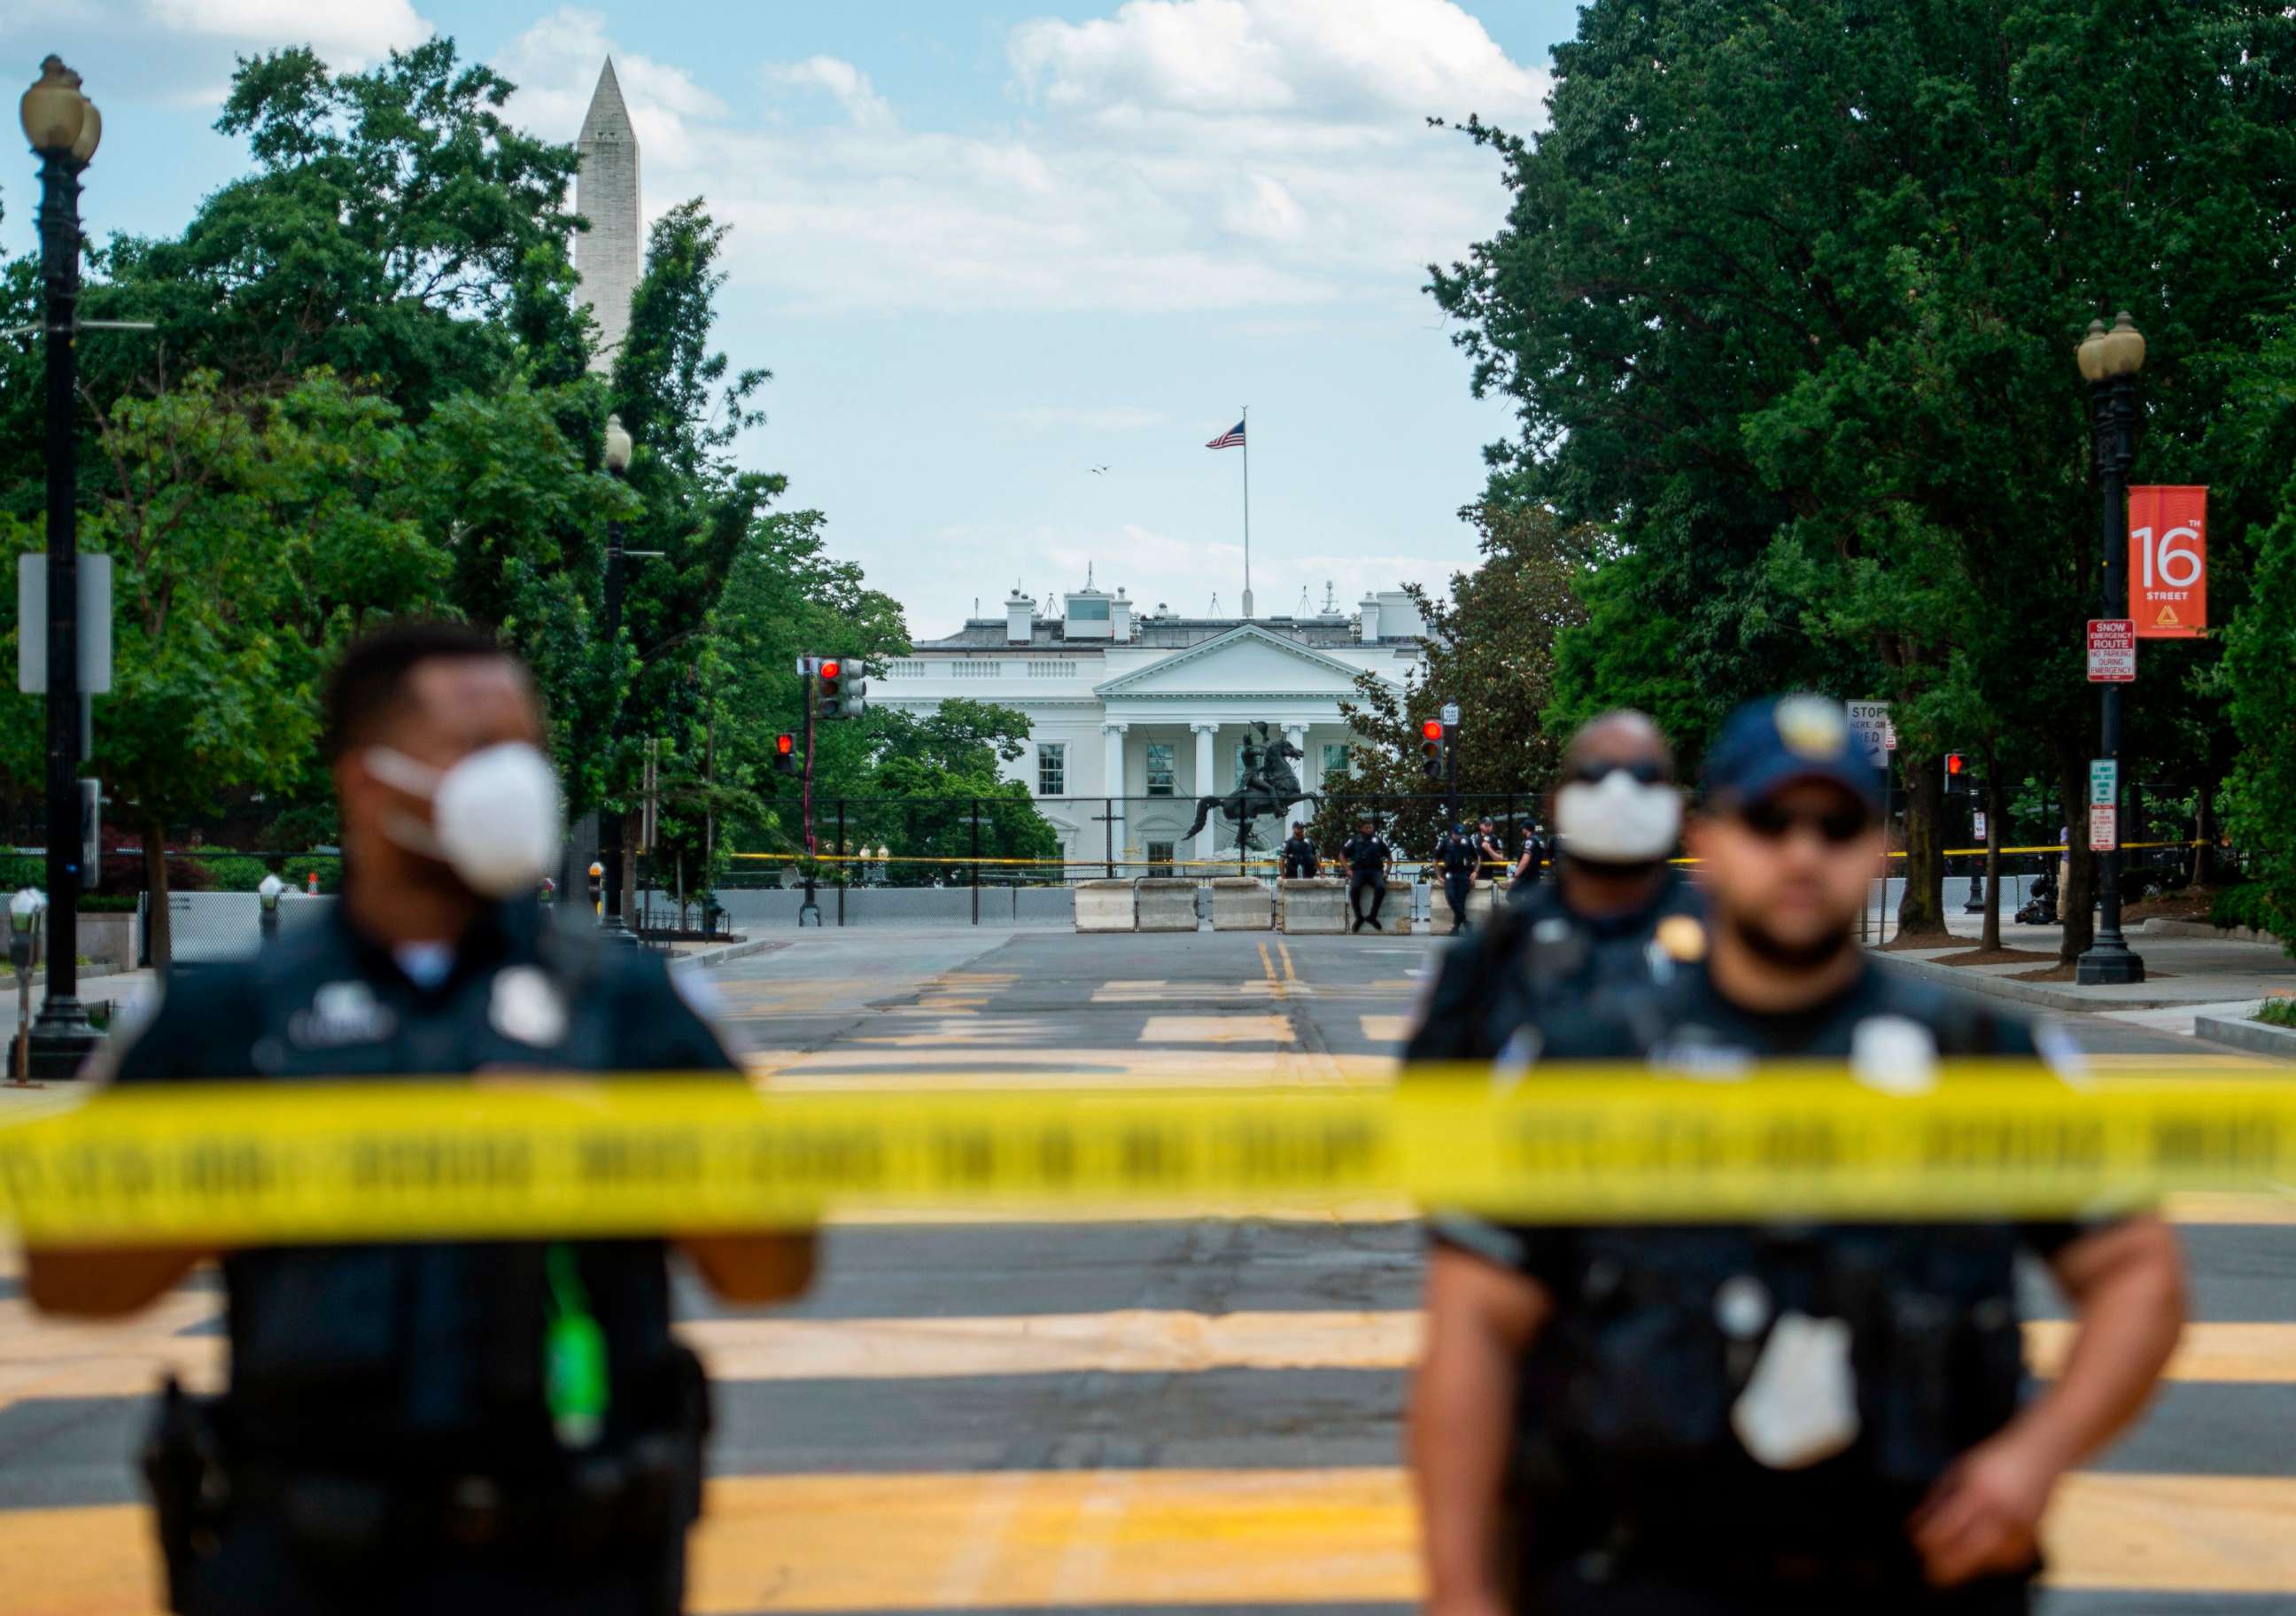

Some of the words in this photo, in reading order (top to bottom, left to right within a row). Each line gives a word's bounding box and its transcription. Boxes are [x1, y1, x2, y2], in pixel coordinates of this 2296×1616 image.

[2131, 526, 2201, 587] 16
[2146, 592, 2188, 601] STREET
[2097, 623, 2125, 632] SNOW
[2094, 640, 2129, 649] ROUTE
[1852, 707, 1885, 718] STOP
